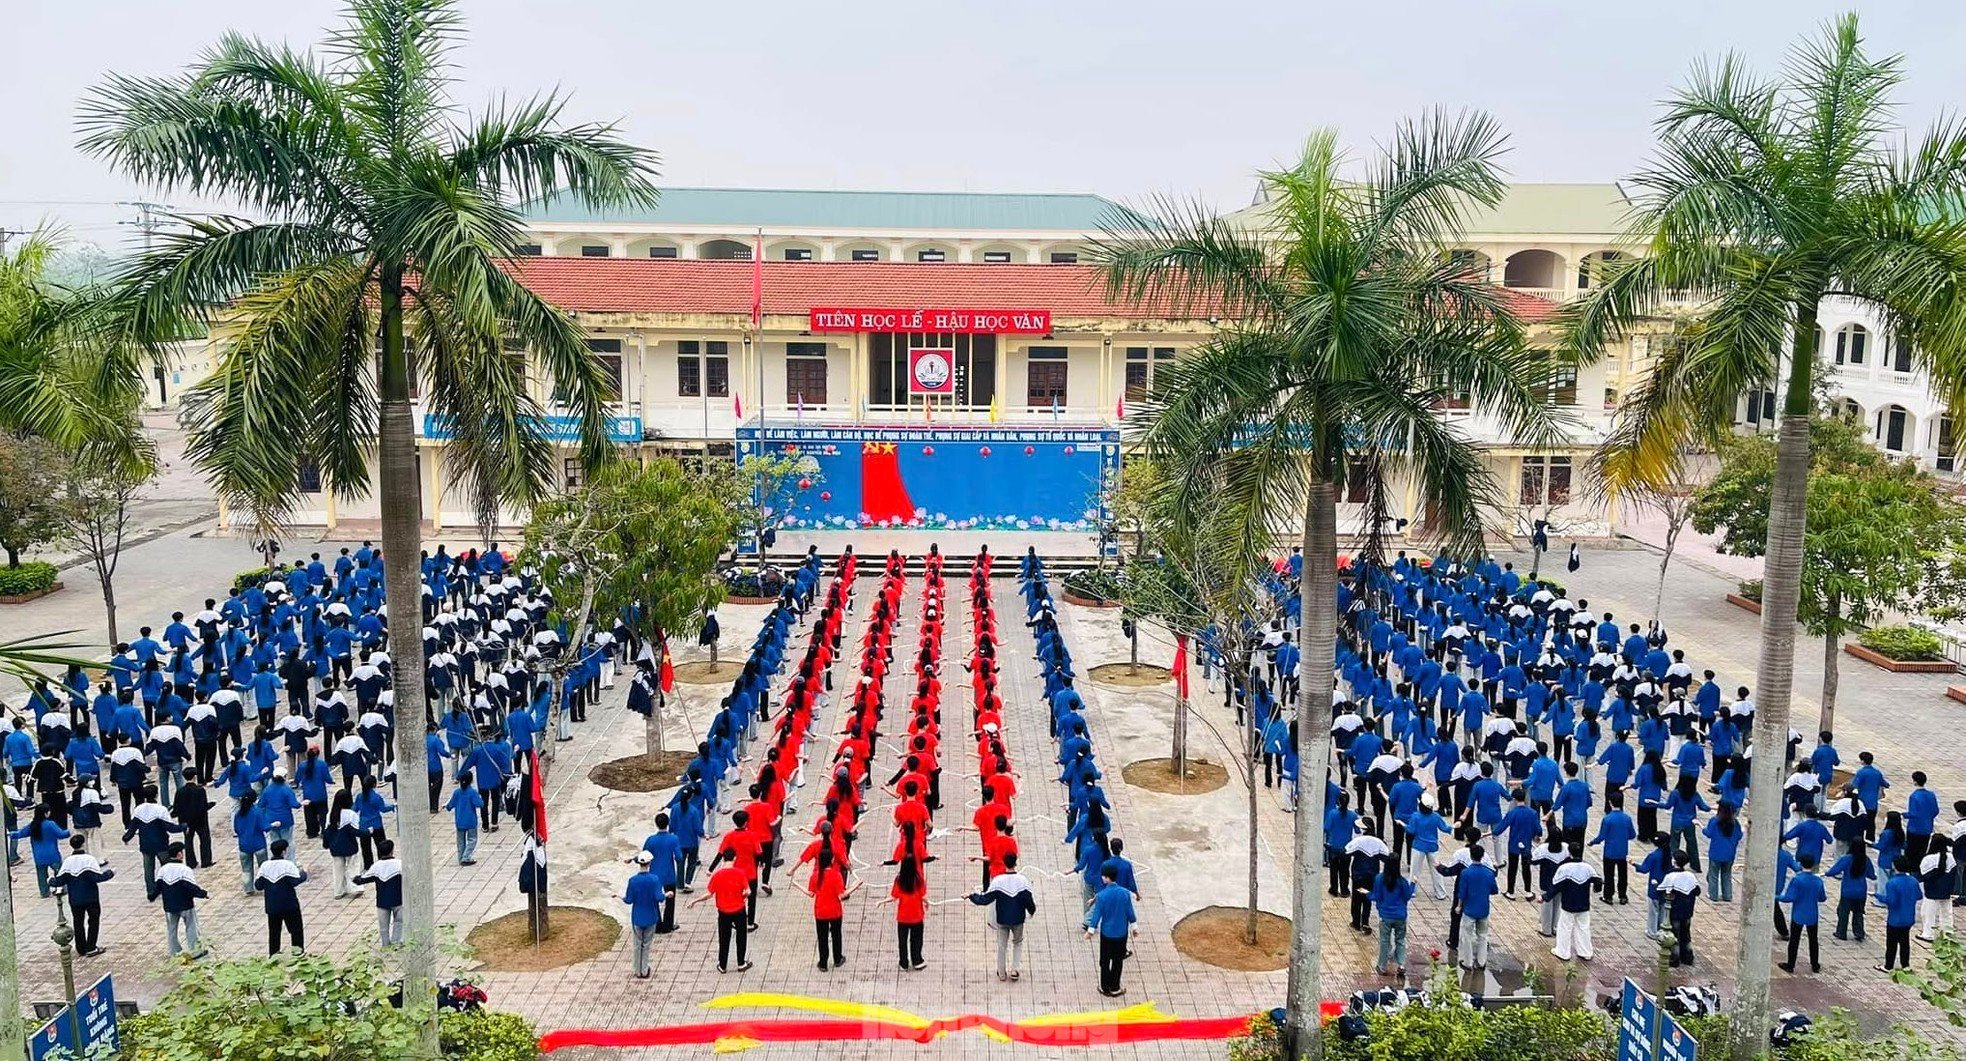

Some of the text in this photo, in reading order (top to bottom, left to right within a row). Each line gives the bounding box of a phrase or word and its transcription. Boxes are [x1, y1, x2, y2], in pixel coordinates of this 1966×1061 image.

[816, 309, 856, 327] TIÊN
[861, 314, 896, 330] HỌC
[935, 311, 969, 331] HẬU
[974, 315, 1009, 331] HỌC
[1013, 313, 1046, 330] VĂN
[774, 428, 785, 439] LÀM
[801, 429, 812, 439] LÀM
[831, 430, 841, 440] LÀM
